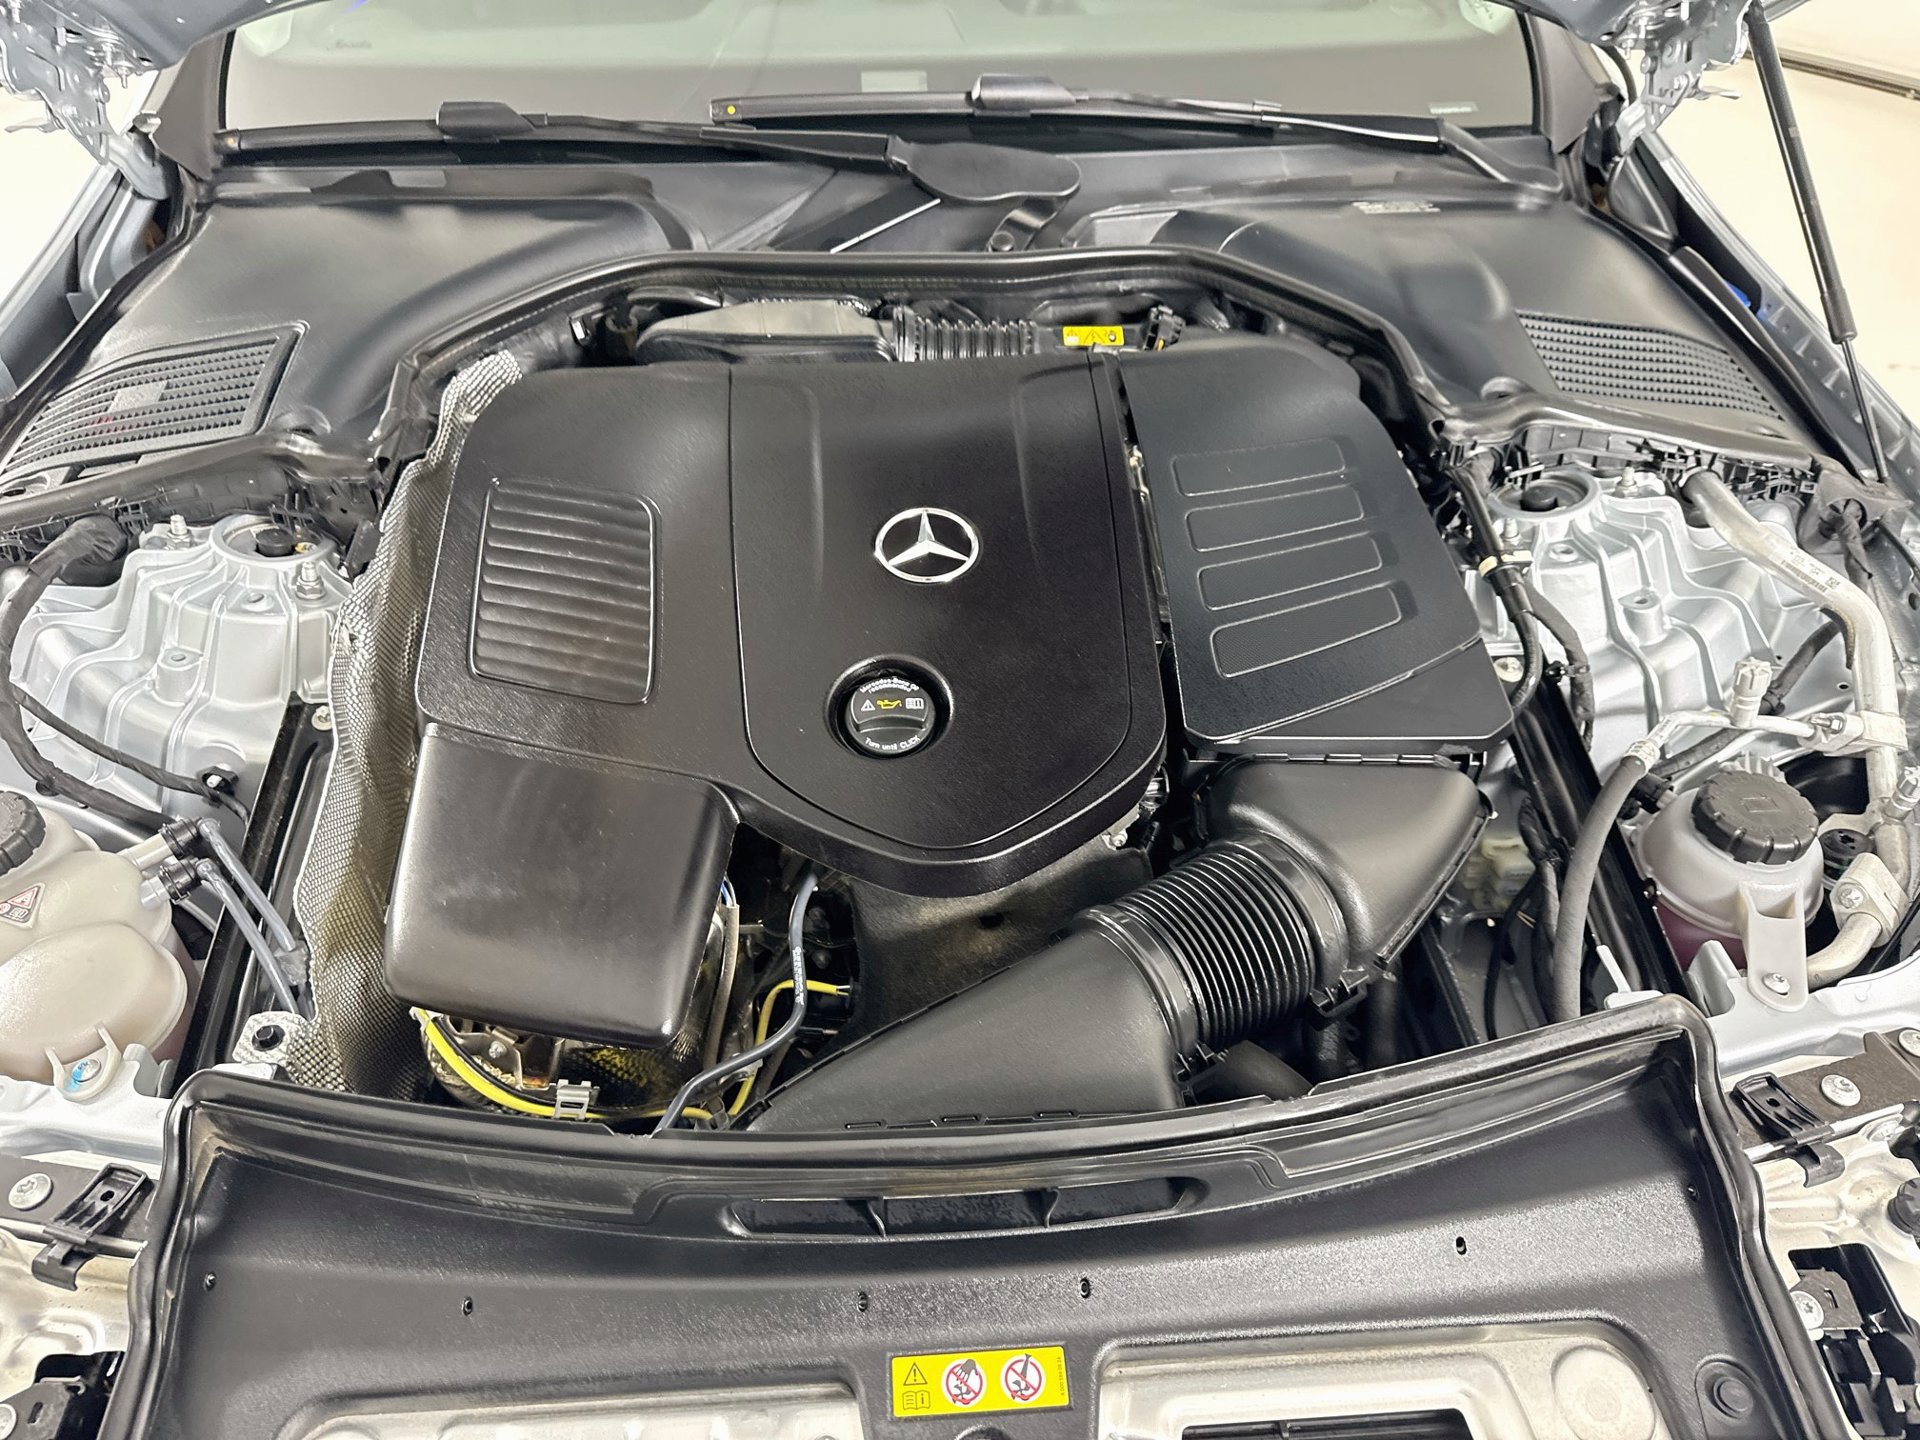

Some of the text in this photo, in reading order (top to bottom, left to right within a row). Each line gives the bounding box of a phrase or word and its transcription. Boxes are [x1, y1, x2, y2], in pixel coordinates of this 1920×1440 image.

[865, 734, 921, 751] Turn until CLICK
